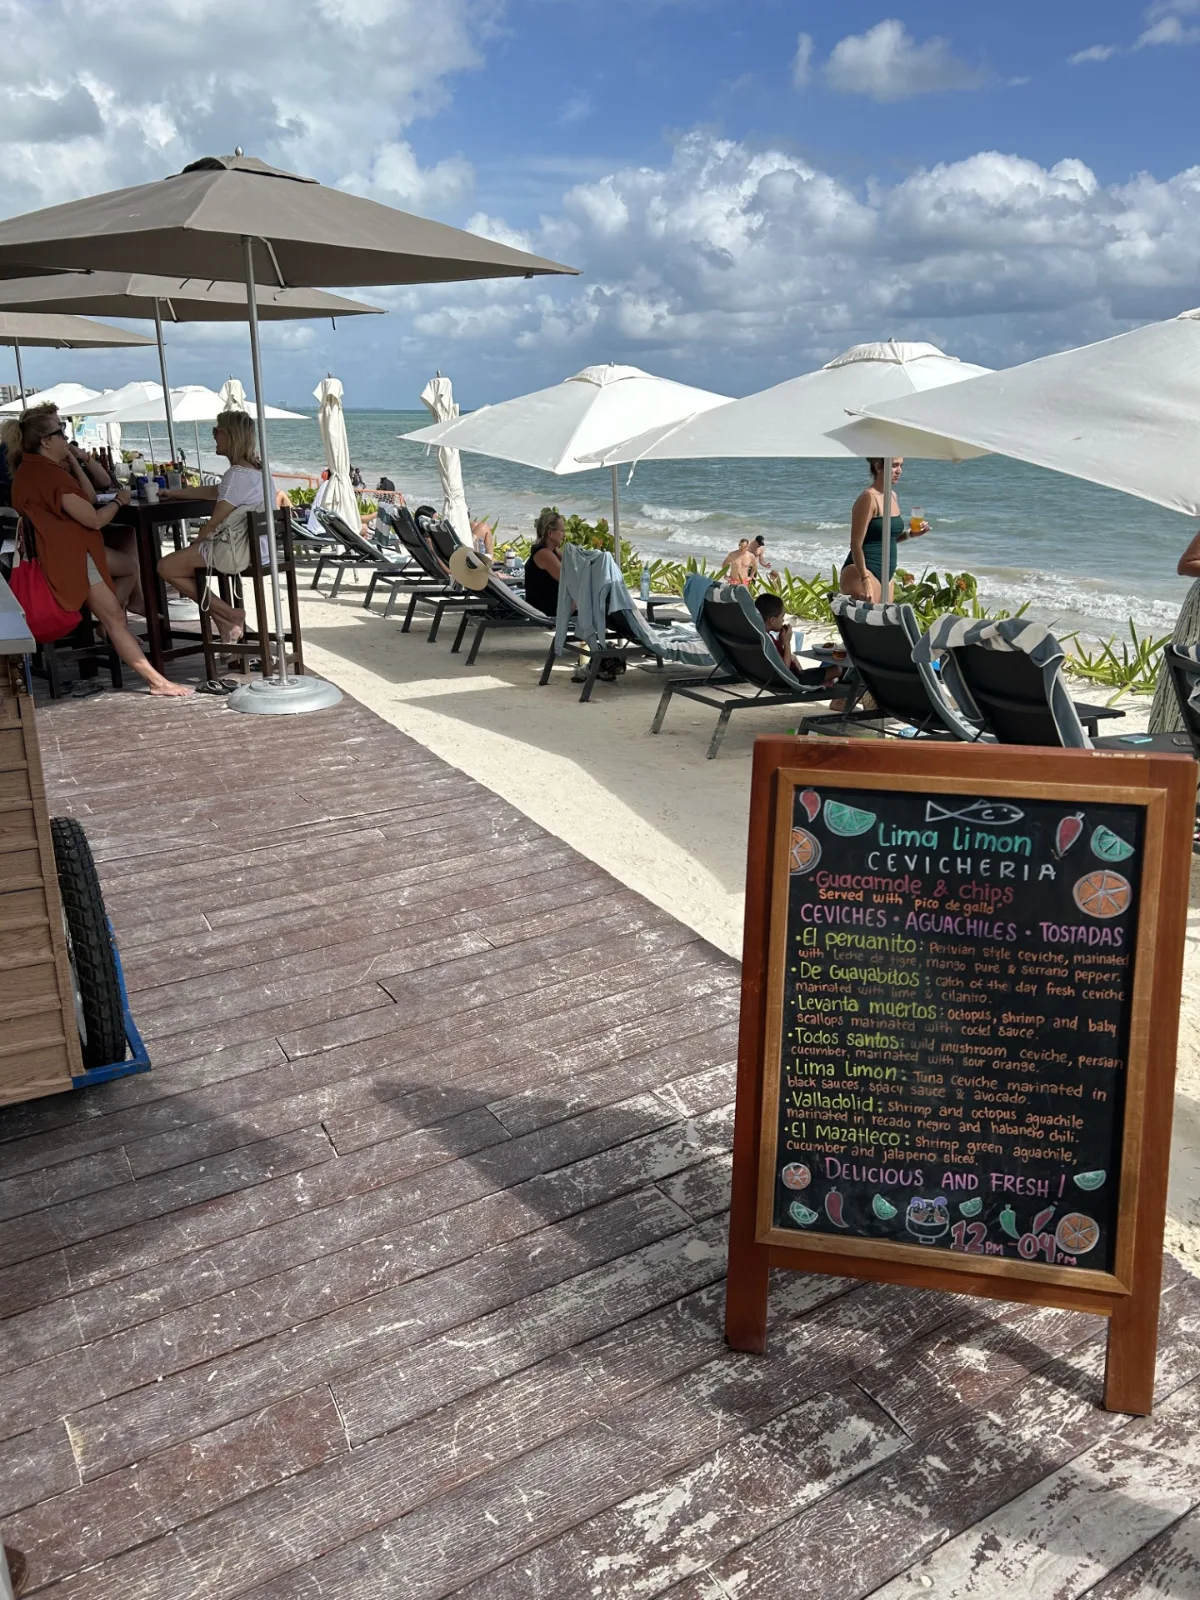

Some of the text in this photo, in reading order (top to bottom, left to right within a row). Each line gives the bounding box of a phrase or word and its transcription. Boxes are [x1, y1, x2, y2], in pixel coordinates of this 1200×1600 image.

[878, 822, 939, 849] Lima
[868, 852, 1056, 881] CEVICHERIA
[816, 870, 922, 894] Guacamole
[933, 879, 948, 897] &
[818, 888, 864, 902] Served
[873, 893, 903, 905] with
[945, 900, 960, 911] de
[801, 903, 1124, 948] CEVICHES AGUACHILES TOSTADAS
[803, 927, 817, 947] El
[983, 947, 1011, 961] style
[1018, 951, 1069, 965] ceviche,
[1073, 953, 1129, 968] marinated
[798, 947, 824, 959] with
[870, 953, 884, 964] de
[926, 958, 966, 972] mango
[1007, 964, 1017, 975] &
[1021, 965, 1069, 978] serrano
[1075, 970, 1121, 984] pepper.
[795, 982, 852, 993] marinated
[858, 986, 884, 996] with
[924, 988, 934, 999] &
[941, 990, 992, 1004] cilantro.
[801, 961, 821, 979] De
[970, 978, 984, 989] of
[987, 980, 1008, 991] the
[1015, 981, 1037, 996] day
[1046, 982, 1075, 997] fresh
[1082, 989, 1126, 1001] ceviche
[798, 994, 859, 1012] Levanta
[1053, 1016, 1079, 1031] and
[1088, 1018, 1117, 1038] baby
[851, 1017, 916, 1032] marinated
[924, 1020, 953, 1034] with
[790, 1045, 1040, 1073] cucumber, marinated with sour orange.
[794, 1027, 839, 1045] Todos
[941, 1043, 1007, 1058] mushroom
[1020, 1048, 1073, 1067] ceviche,
[787, 1074, 816, 1087] black
[911, 1085, 946, 1098] sauce
[956, 1088, 966, 1100] &
[974, 1090, 1031, 1104] avocado.
[796, 1058, 835, 1076] Lima
[912, 1070, 944, 1084] Tuna
[951, 1076, 998, 1090] ceviche
[1007, 1081, 1084, 1097] marinated
[1092, 1087, 1107, 1102] in
[786, 1108, 848, 1122] marinated
[853, 1113, 865, 1125] in
[872, 1115, 912, 1128] recado
[917, 1118, 951, 1132] negro
[959, 1121, 981, 1133] and
[991, 1121, 1044, 1138] habanero
[939, 1105, 963, 1118] and
[971, 1107, 1017, 1122] octopus
[1025, 1113, 1084, 1130] aguachile
[786, 1140, 847, 1153] cucumber
[851, 1146, 874, 1158] and
[882, 1147, 937, 1163] jalapeno
[792, 1122, 806, 1139] El
[967, 1141, 1003, 1155] green
[941, 1171, 979, 1190] AND
